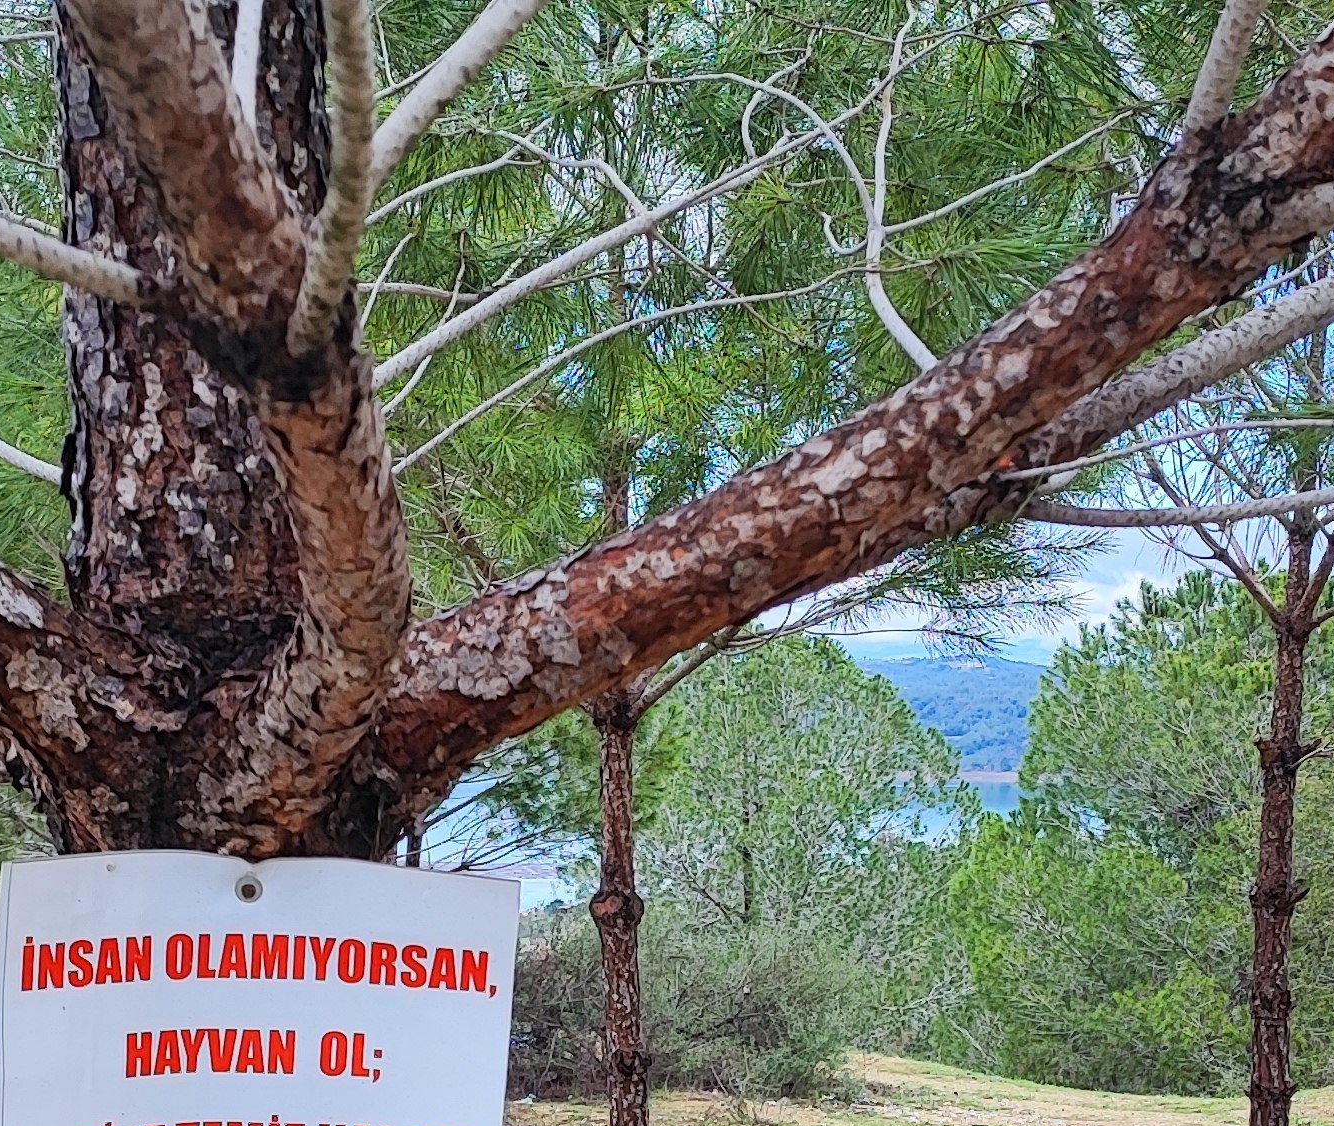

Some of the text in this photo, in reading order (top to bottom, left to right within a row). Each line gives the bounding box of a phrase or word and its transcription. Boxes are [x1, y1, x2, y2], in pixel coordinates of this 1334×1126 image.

[20, 931, 498, 998] İNSAN OLAMIYORSAN,
[125, 1028, 384, 1082] HAYVAN OL;
